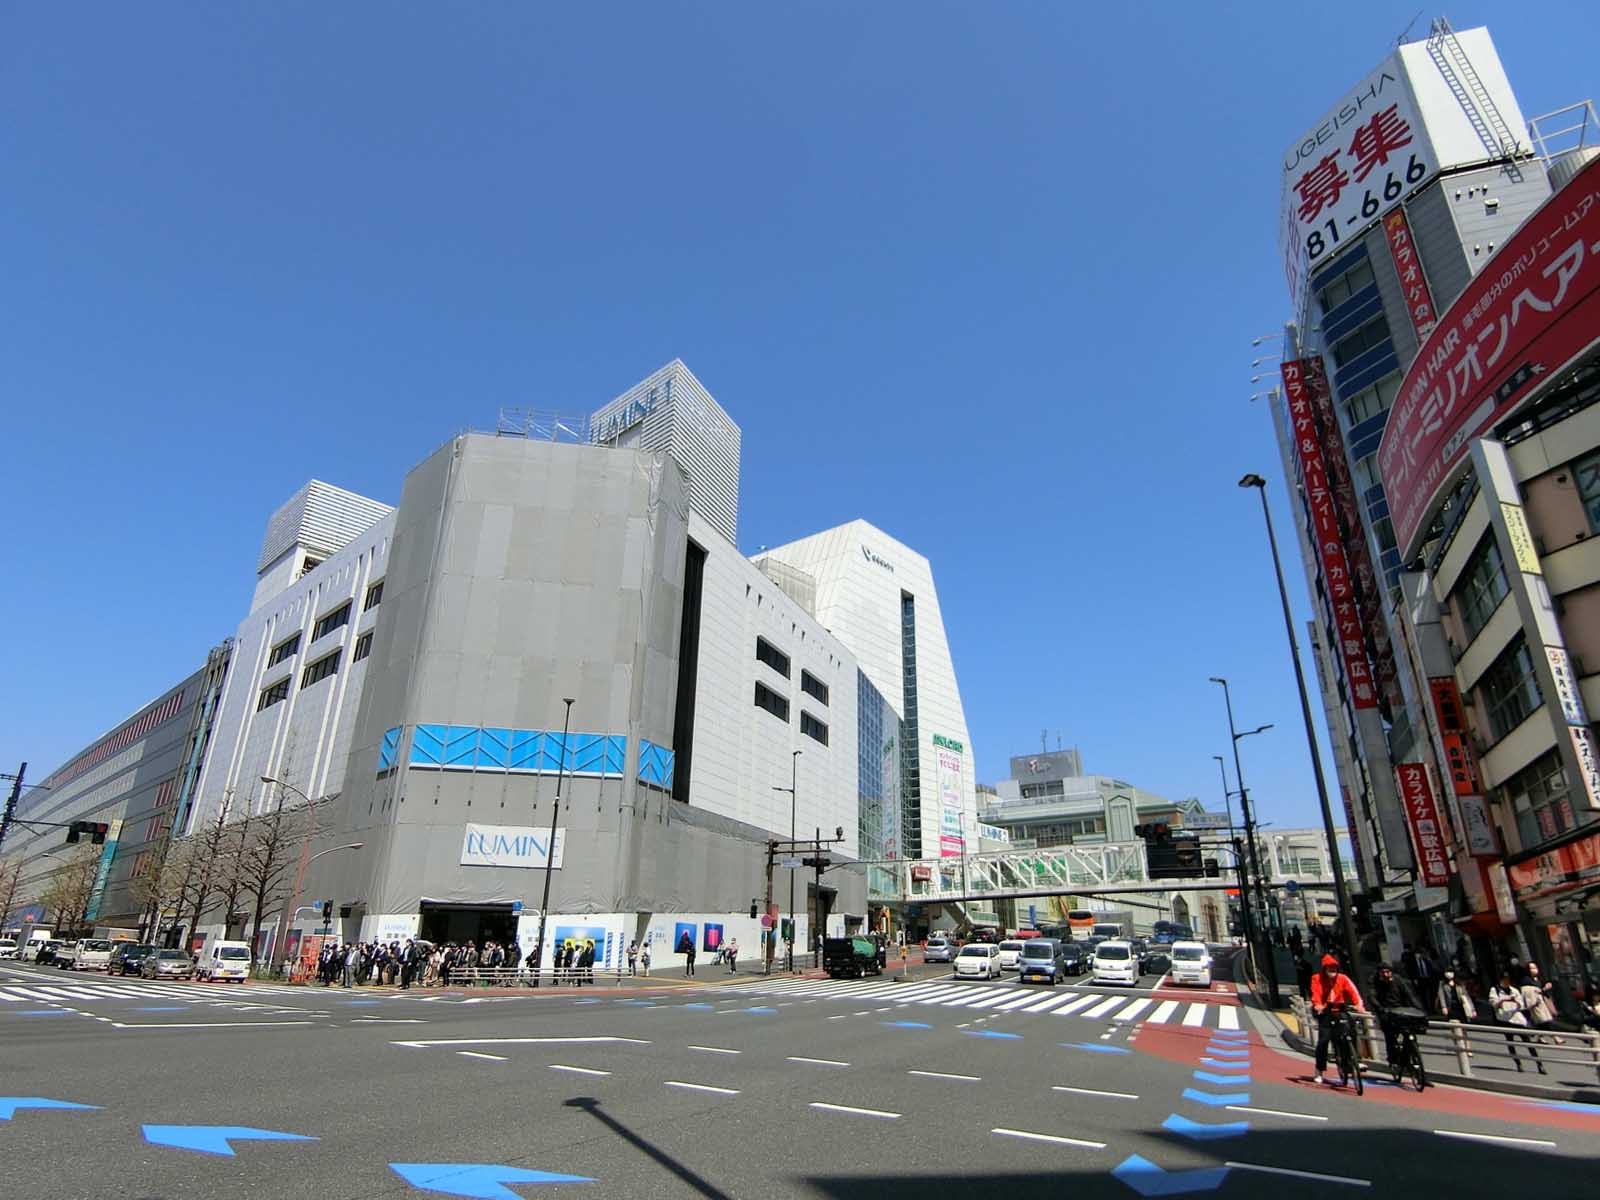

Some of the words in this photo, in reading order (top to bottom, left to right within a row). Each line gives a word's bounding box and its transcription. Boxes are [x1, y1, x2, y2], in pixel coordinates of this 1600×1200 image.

[1293, 102, 1414, 224] 募集
[1307, 154, 1426, 259] 81-666
[1425, 328, 1460, 380] HAIR
